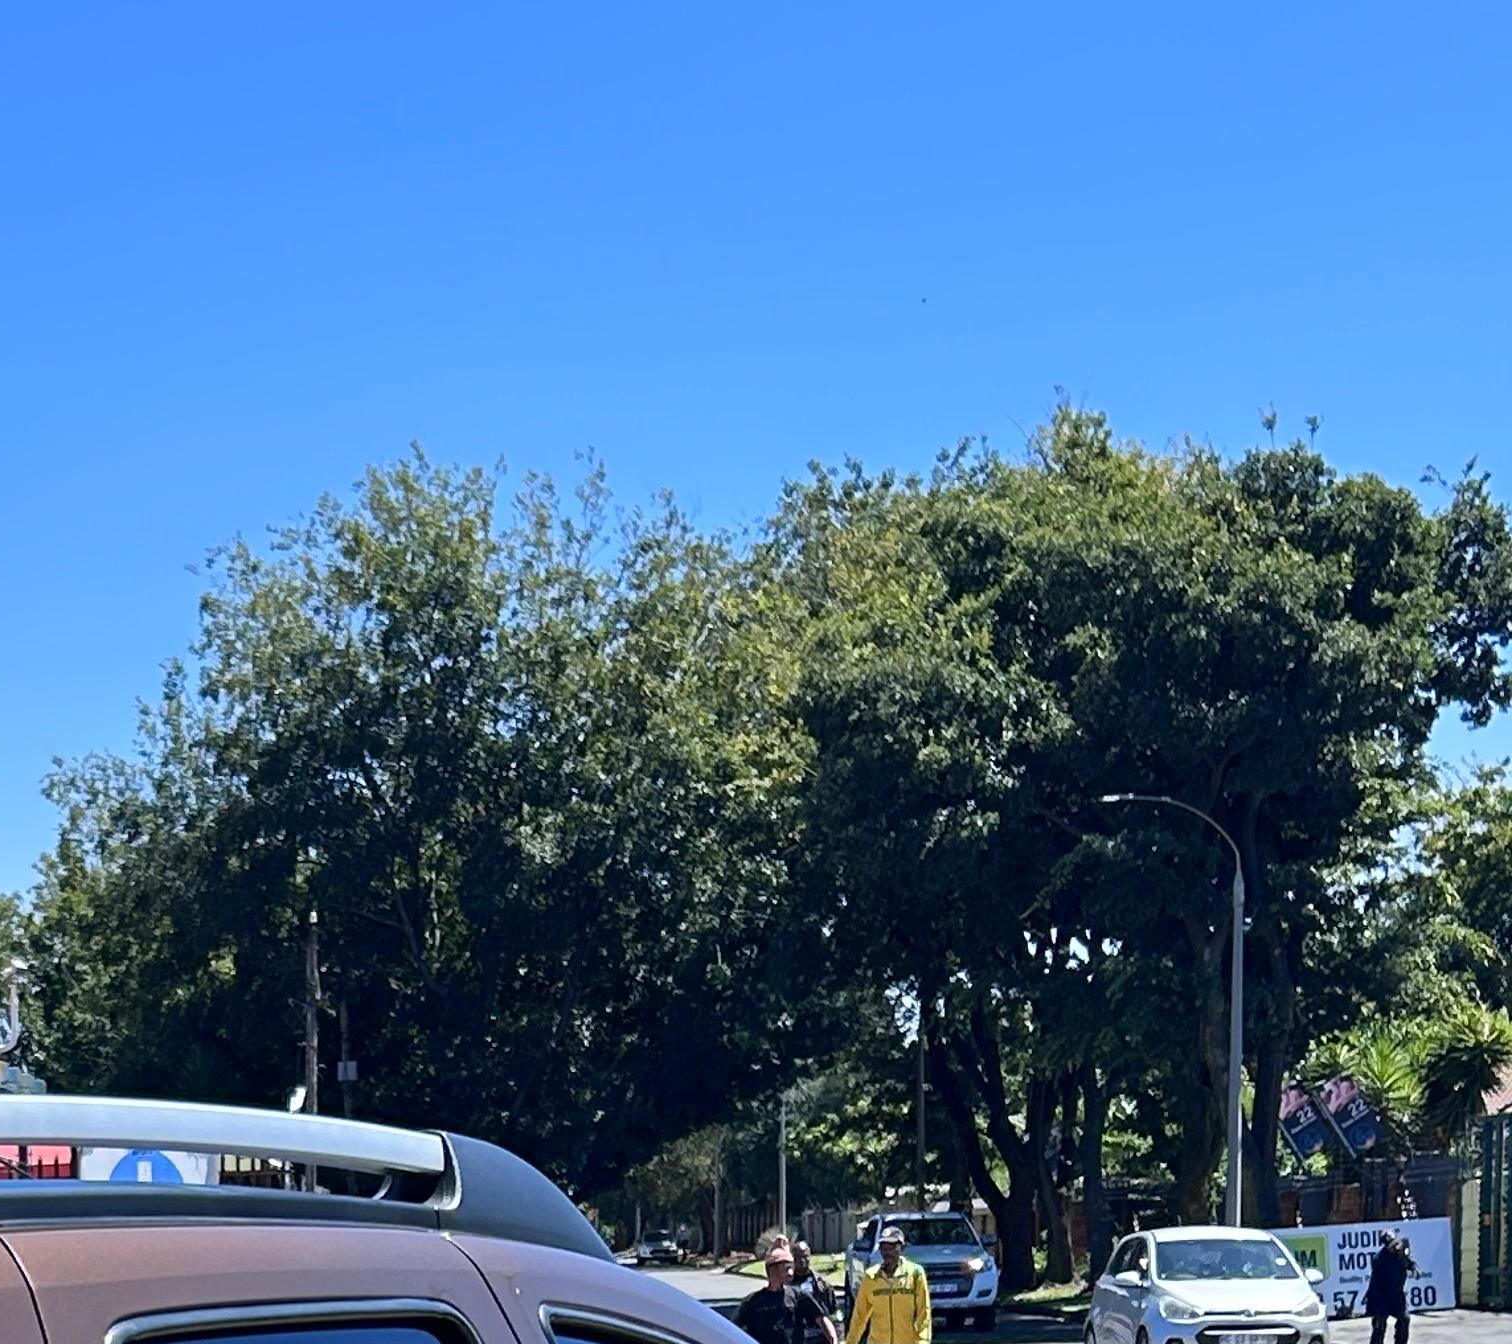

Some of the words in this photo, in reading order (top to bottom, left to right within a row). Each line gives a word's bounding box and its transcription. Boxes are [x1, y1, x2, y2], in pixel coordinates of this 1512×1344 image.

[1348, 1098, 1368, 1117] 22
[1339, 1252, 1377, 1271] MOT
[1404, 1285, 1436, 1307] 80
